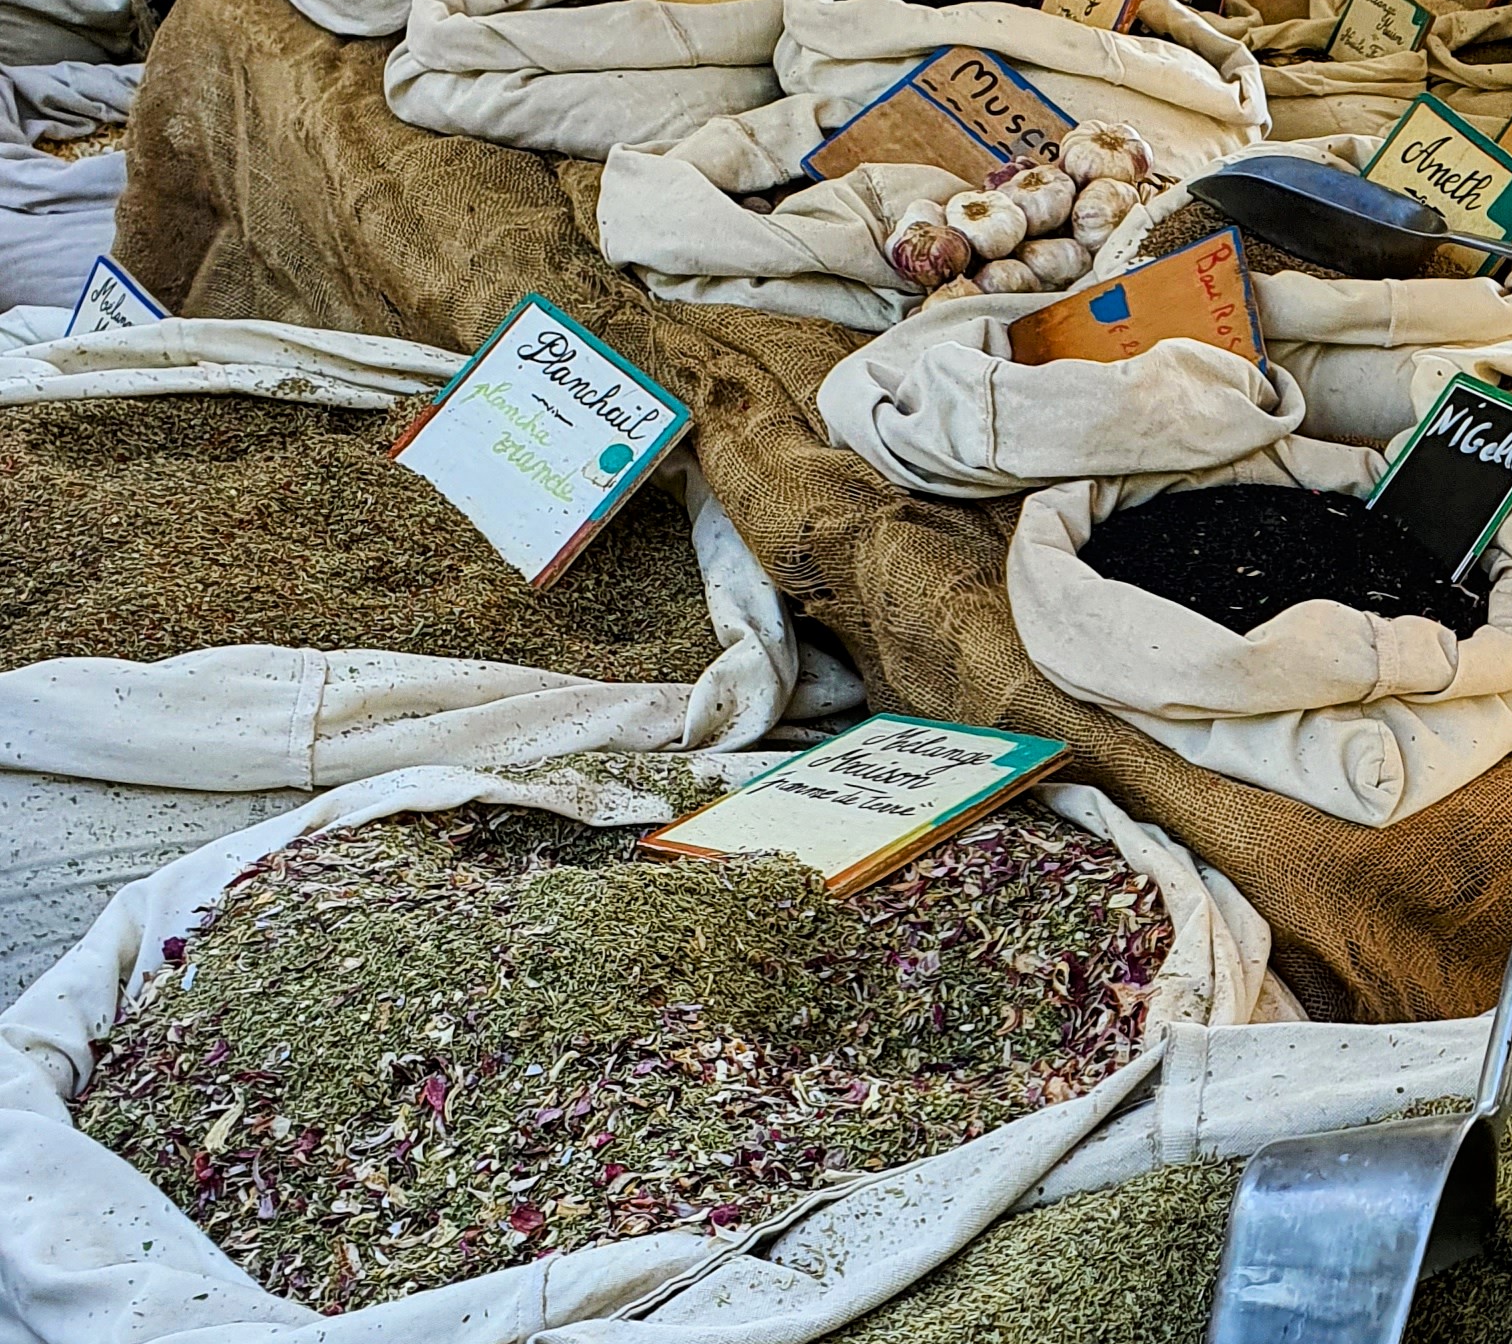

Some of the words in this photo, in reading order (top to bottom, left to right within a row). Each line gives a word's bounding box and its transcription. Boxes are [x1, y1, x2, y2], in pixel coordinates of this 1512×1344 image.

[950, 60, 1061, 163] MUSCA
[1400, 136, 1493, 212] Aneth
[91, 277, 134, 328] Mélan
[459, 381, 552, 447] plancha
[807, 748, 937, 790] Maison
[861, 727, 993, 775] Mélange
[830, 791, 861, 807] de
